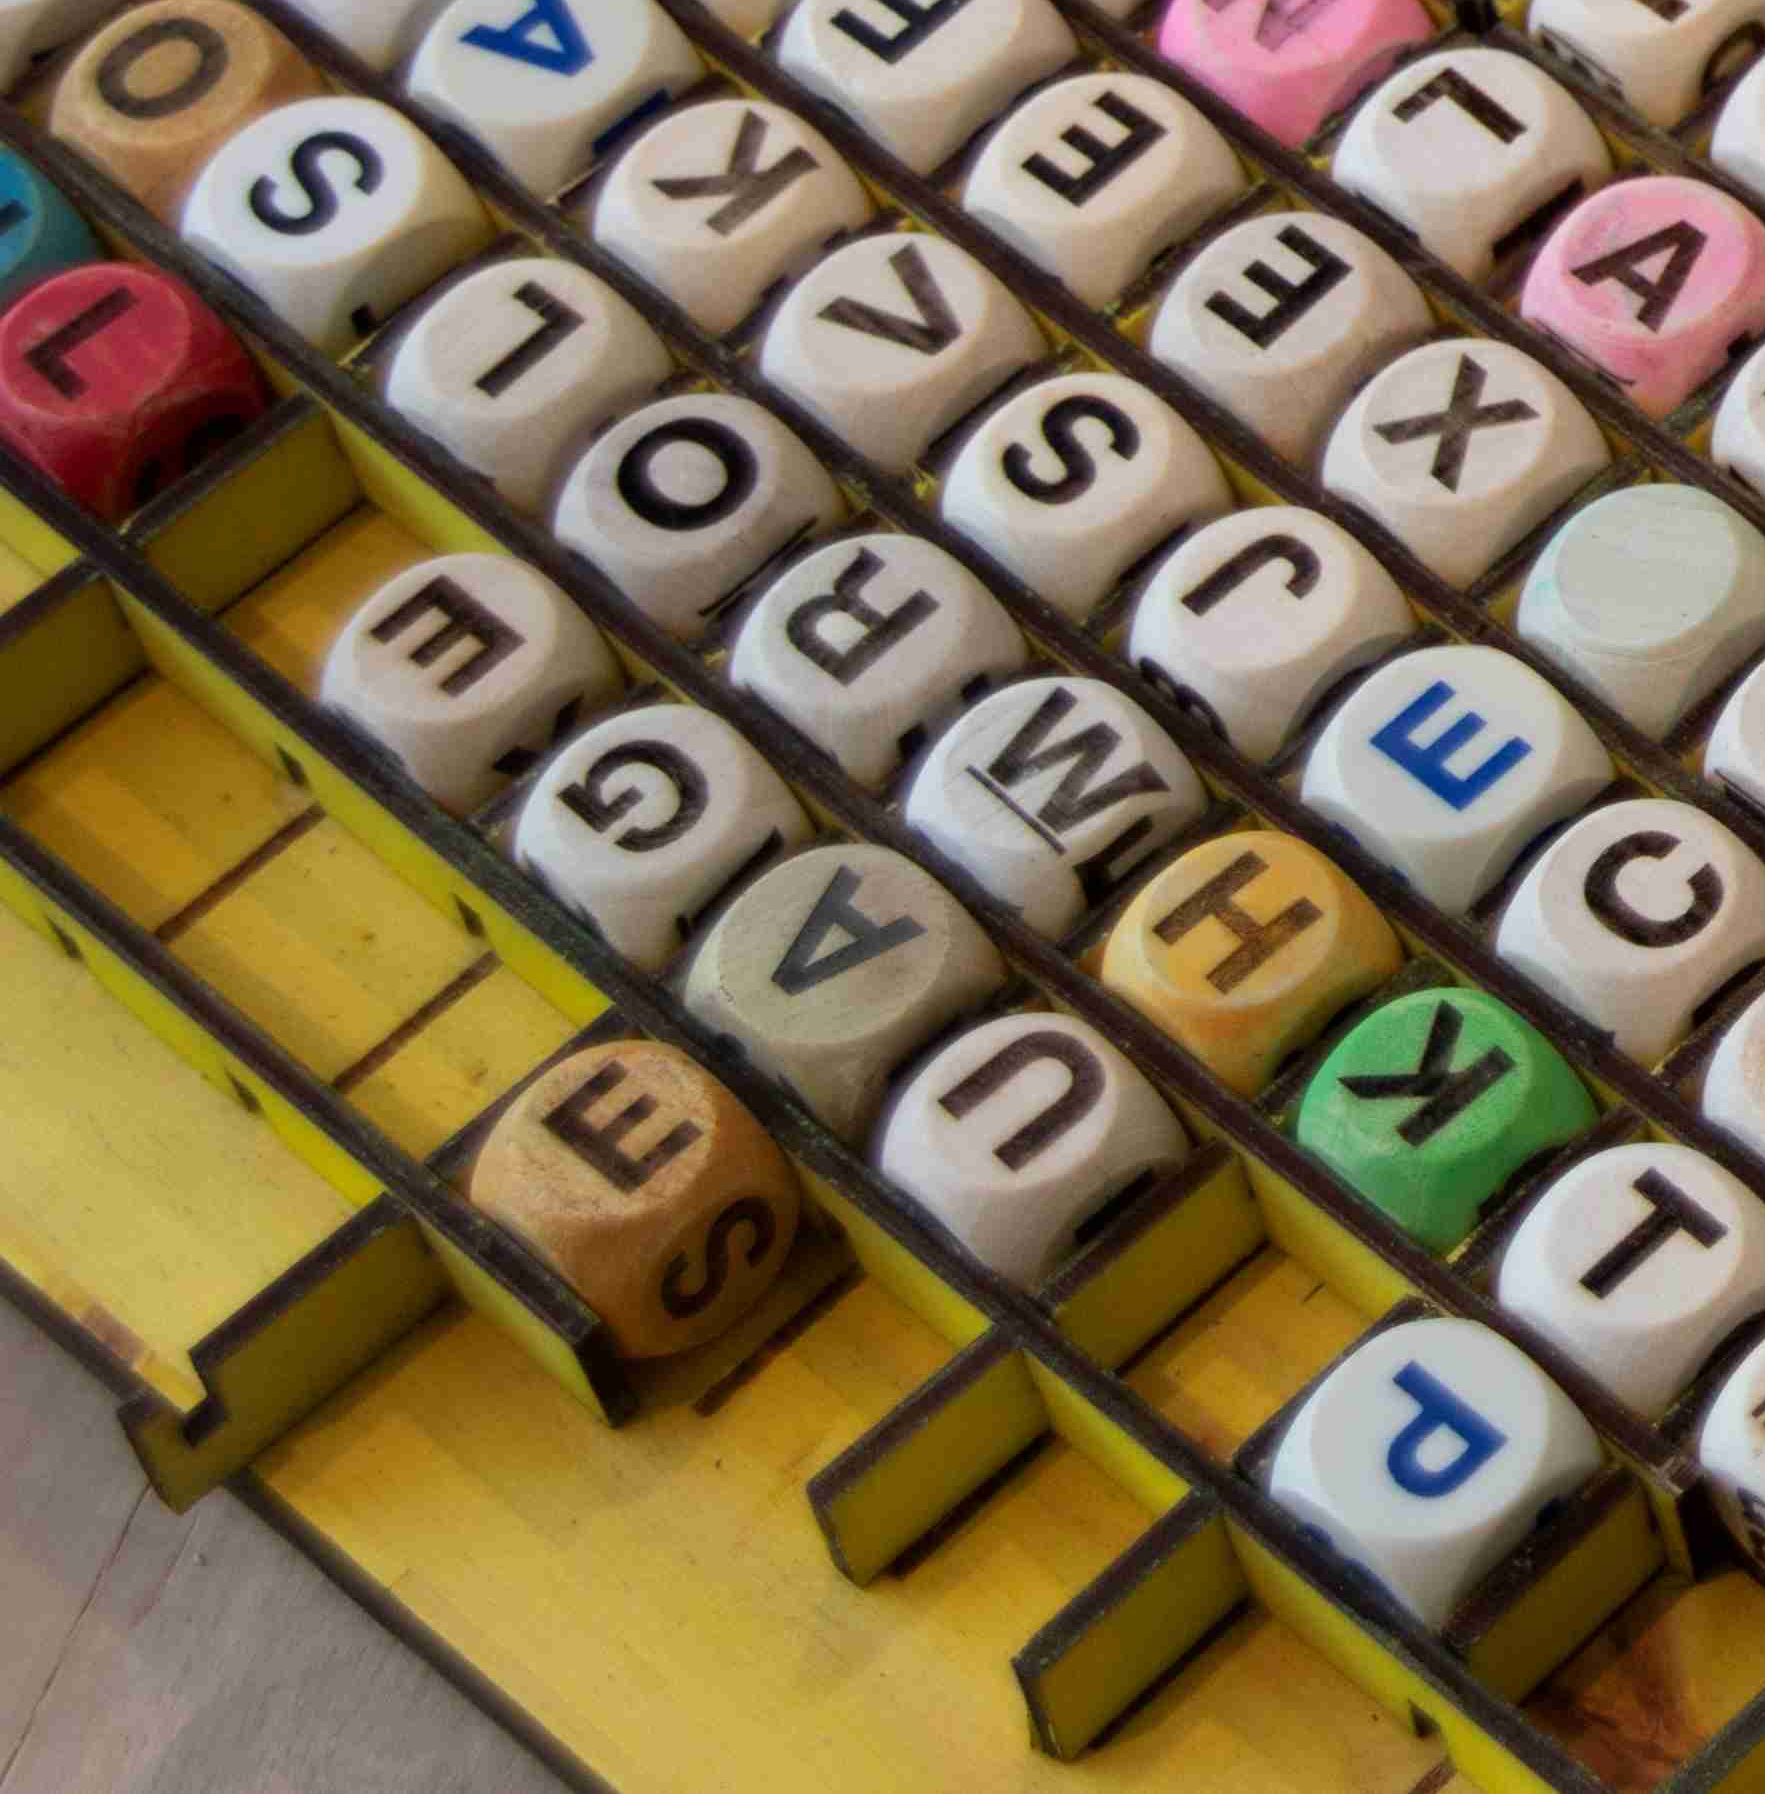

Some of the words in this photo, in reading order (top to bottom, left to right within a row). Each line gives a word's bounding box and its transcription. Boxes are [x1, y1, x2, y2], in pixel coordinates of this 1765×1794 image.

[1022, 92, 1165, 206] E
[1393, 68, 1525, 143] L
[249, 132, 381, 235] S
[475, 282, 582, 397] L
[1205, 226, 1350, 348] E
[616, 418, 756, 531] O
[1002, 395, 1138, 504] S
[1181, 534, 1319, 615] J
[558, 741, 706, 852] G
[1370, 682, 1530, 810] E
[1584, 832, 1722, 948] C
[541, 1063, 701, 1193] E
[938, 1032, 1103, 1171] U
[1340, 1003, 1513, 1146] K
[1580, 1170, 1725, 1298] T
